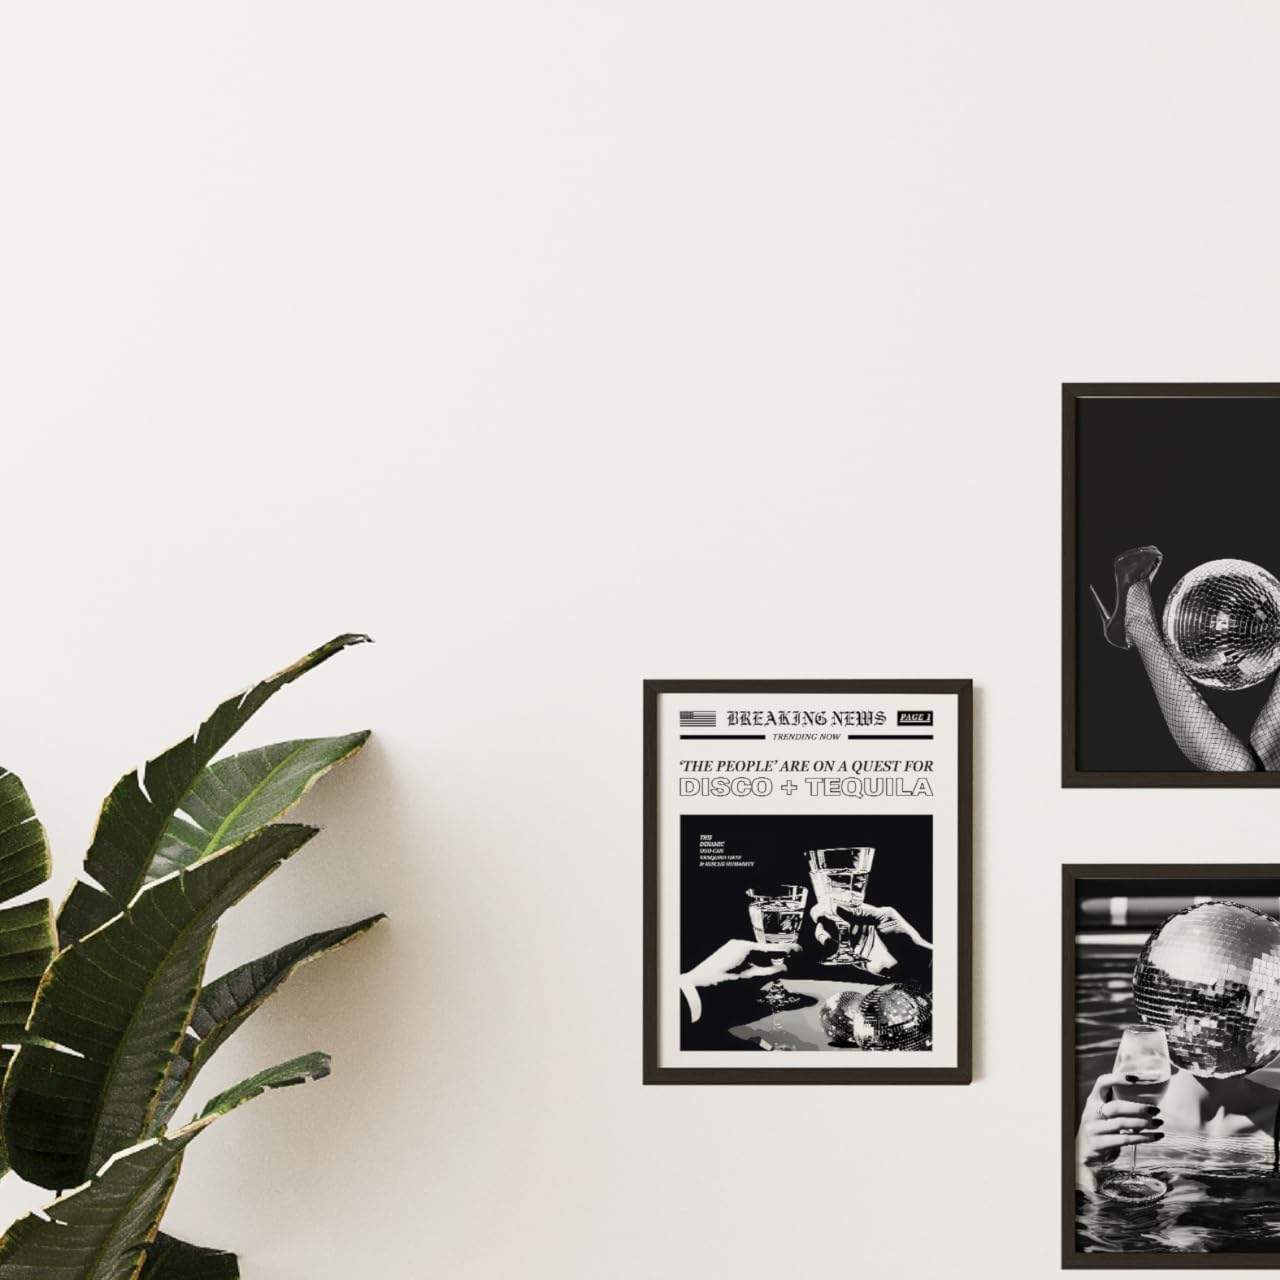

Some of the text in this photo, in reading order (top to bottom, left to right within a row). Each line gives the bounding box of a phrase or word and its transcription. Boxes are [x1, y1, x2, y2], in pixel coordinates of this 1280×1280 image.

[727, 710, 887, 727] BREAKING NEWS
[900, 713, 924, 721] PAGE
[772, 733, 841, 741] TRENDING NOW
[679, 760, 934, 775] ‘THE PEOPLE’ ARE ON A QUEST FOR
[679, 777, 934, 800] DISCO + TEQUILA
